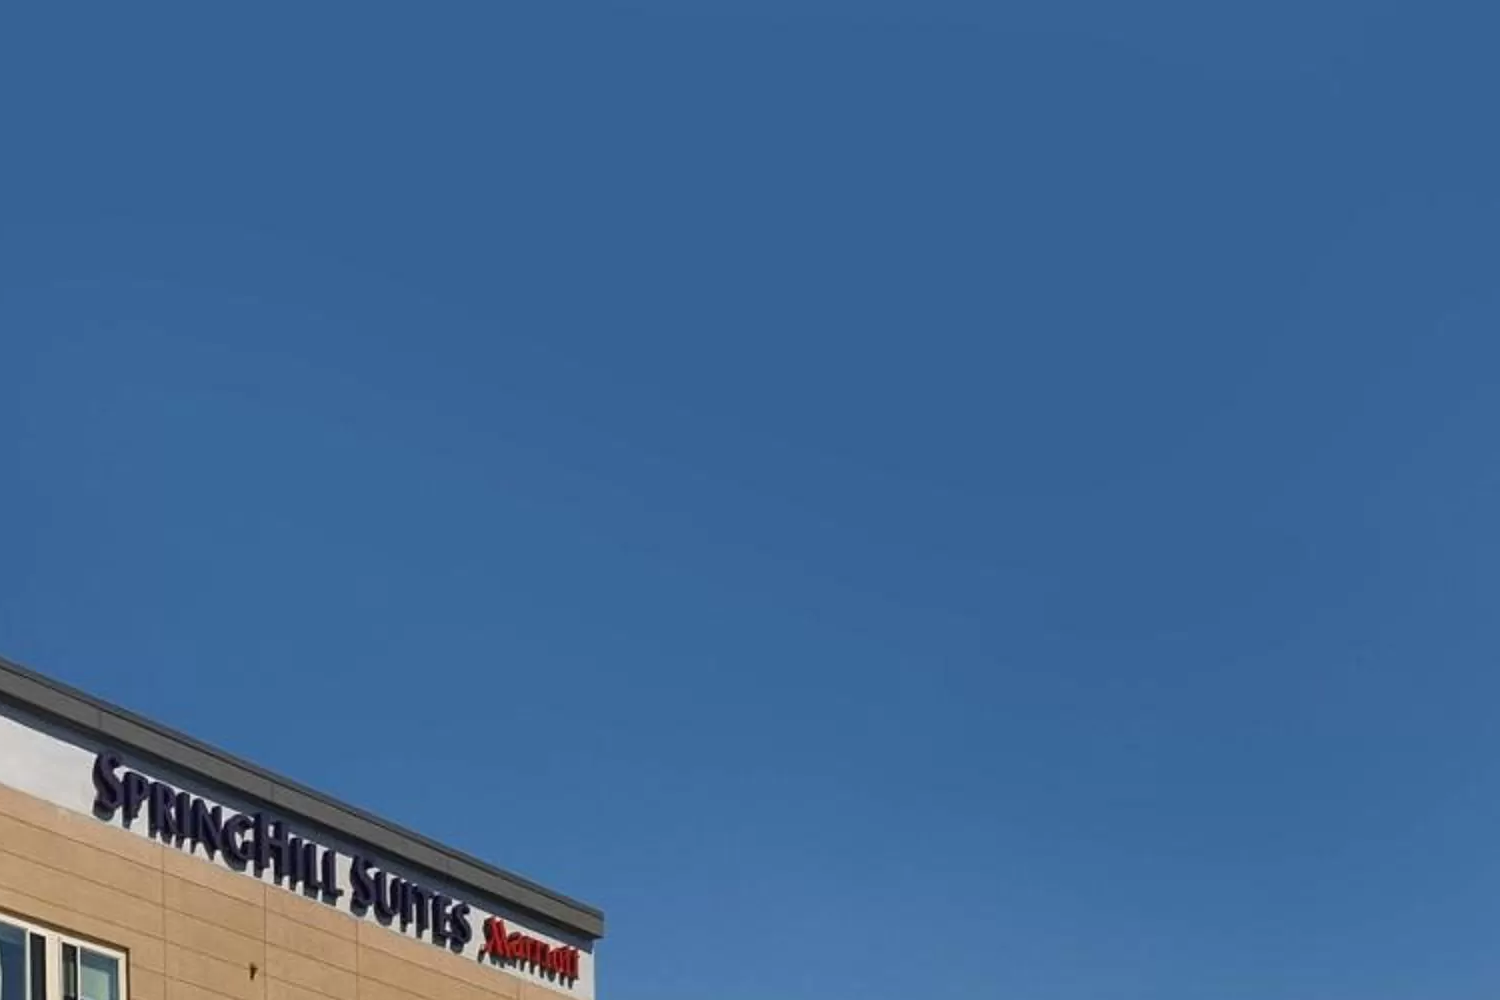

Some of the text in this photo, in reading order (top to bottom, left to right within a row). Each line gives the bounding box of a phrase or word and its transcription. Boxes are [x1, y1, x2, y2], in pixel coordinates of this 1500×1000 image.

[92, 752, 580, 989] SPRINGHILL SUITES Marriott
